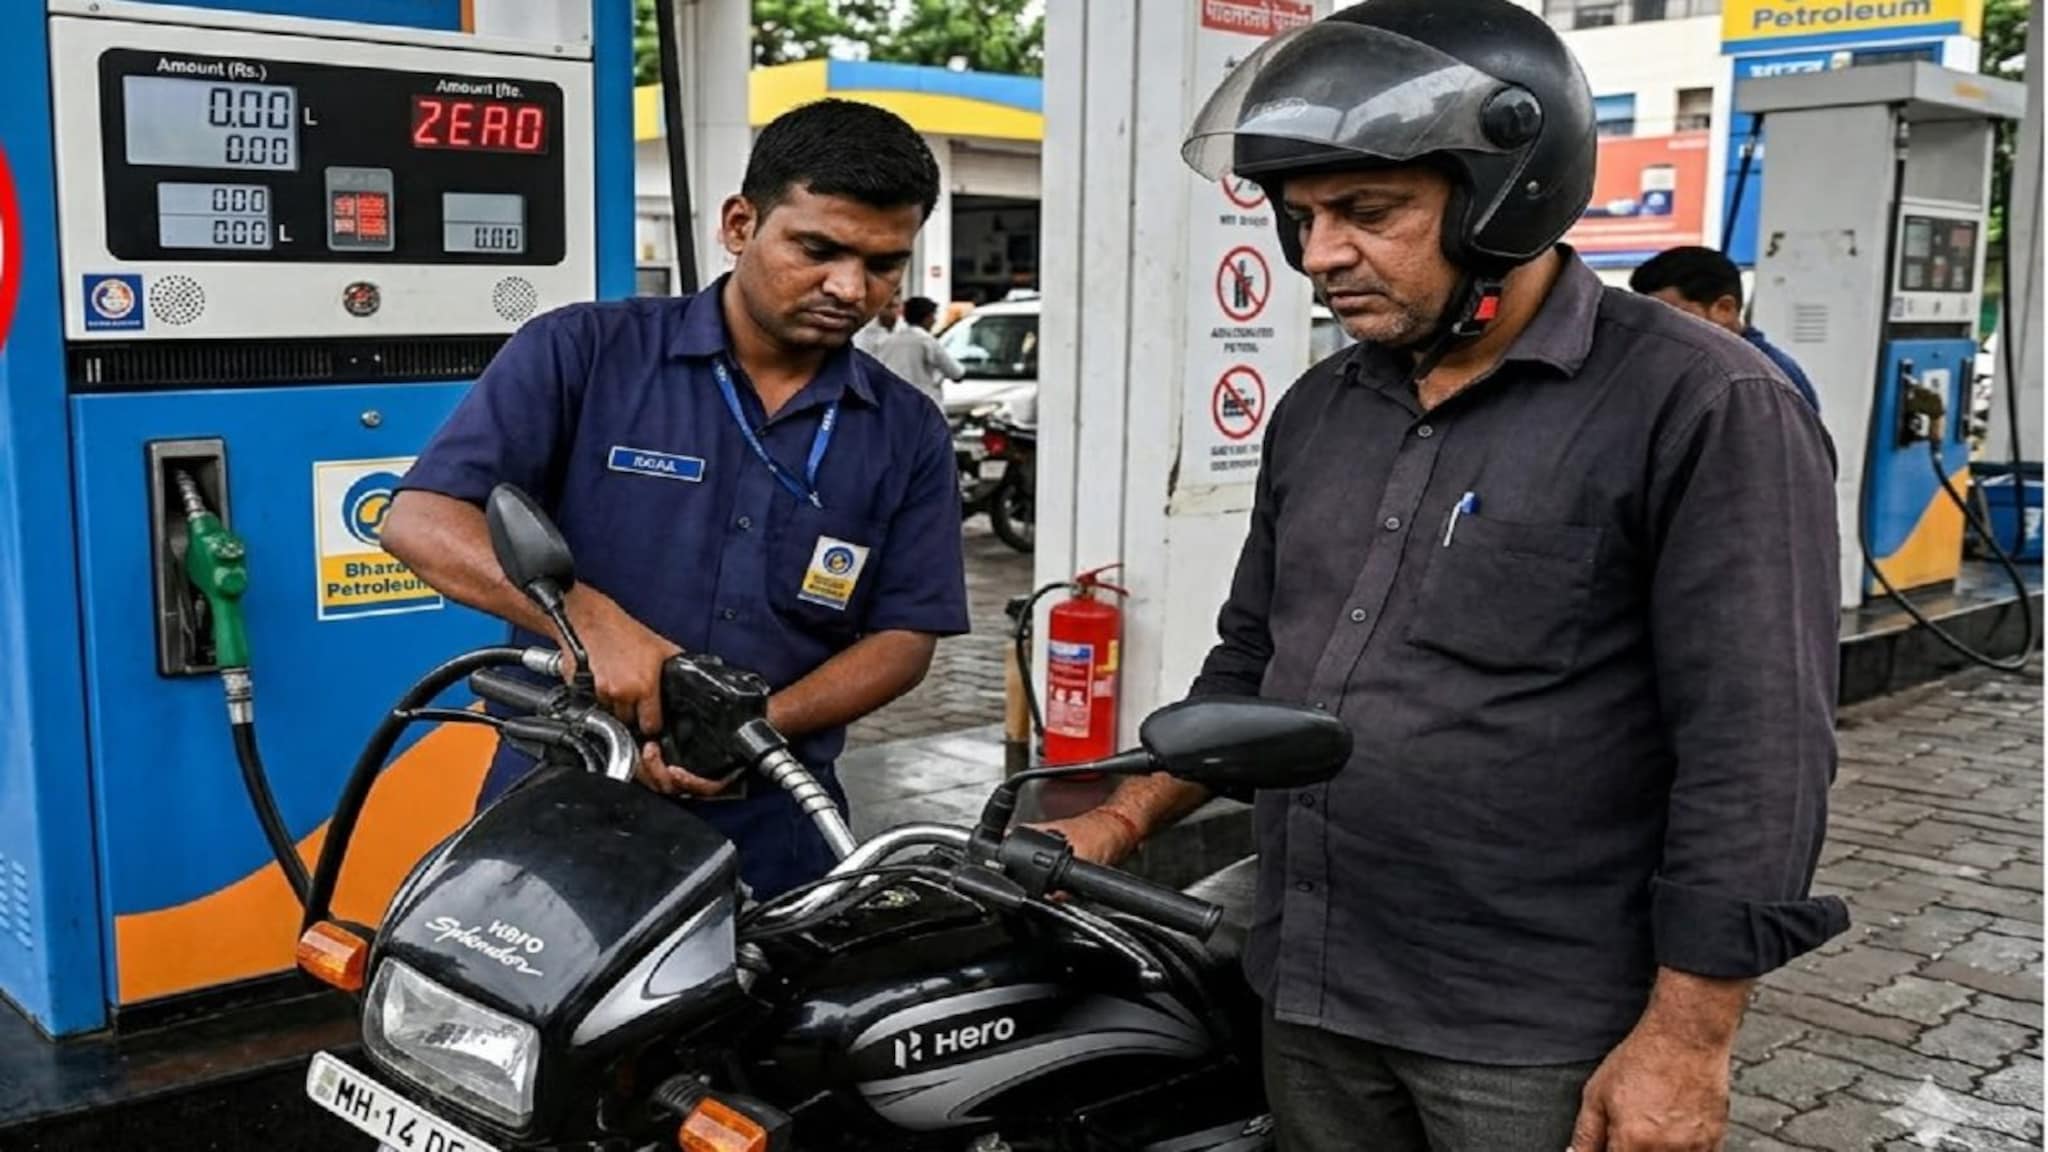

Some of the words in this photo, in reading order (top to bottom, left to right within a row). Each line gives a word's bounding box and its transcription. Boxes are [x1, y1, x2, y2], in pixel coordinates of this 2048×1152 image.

[1752, 0, 1931, 30] Petroleum
[156, 57, 225, 76] Amount
[228, 62, 267, 81] (Rs.)
[435, 79, 493, 95] Amount
[209, 87, 289, 129] 0.00
[304, 107, 318, 126] L
[279, 224, 294, 242] L
[345, 562, 412, 578] Bhara
[934, 1017, 1016, 1056] Hero
